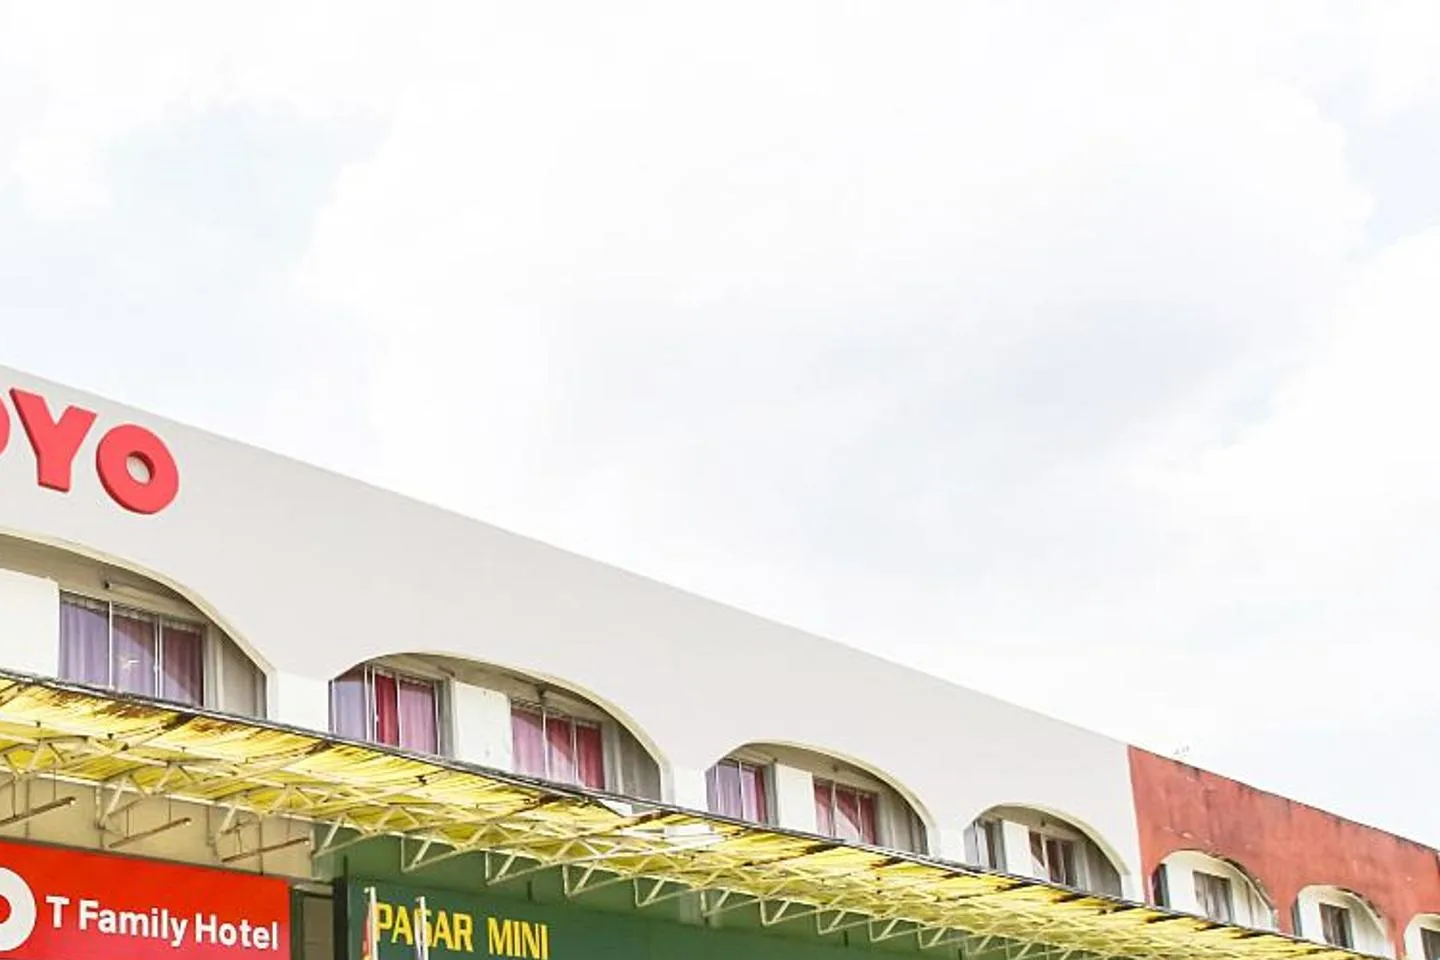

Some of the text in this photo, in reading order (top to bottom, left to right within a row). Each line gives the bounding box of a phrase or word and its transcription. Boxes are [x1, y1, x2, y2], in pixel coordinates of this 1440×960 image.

[45, 895, 70, 928] T
[78, 899, 188, 947] Family
[195, 912, 279, 951] Hotel
[487, 916, 549, 960] MINI
